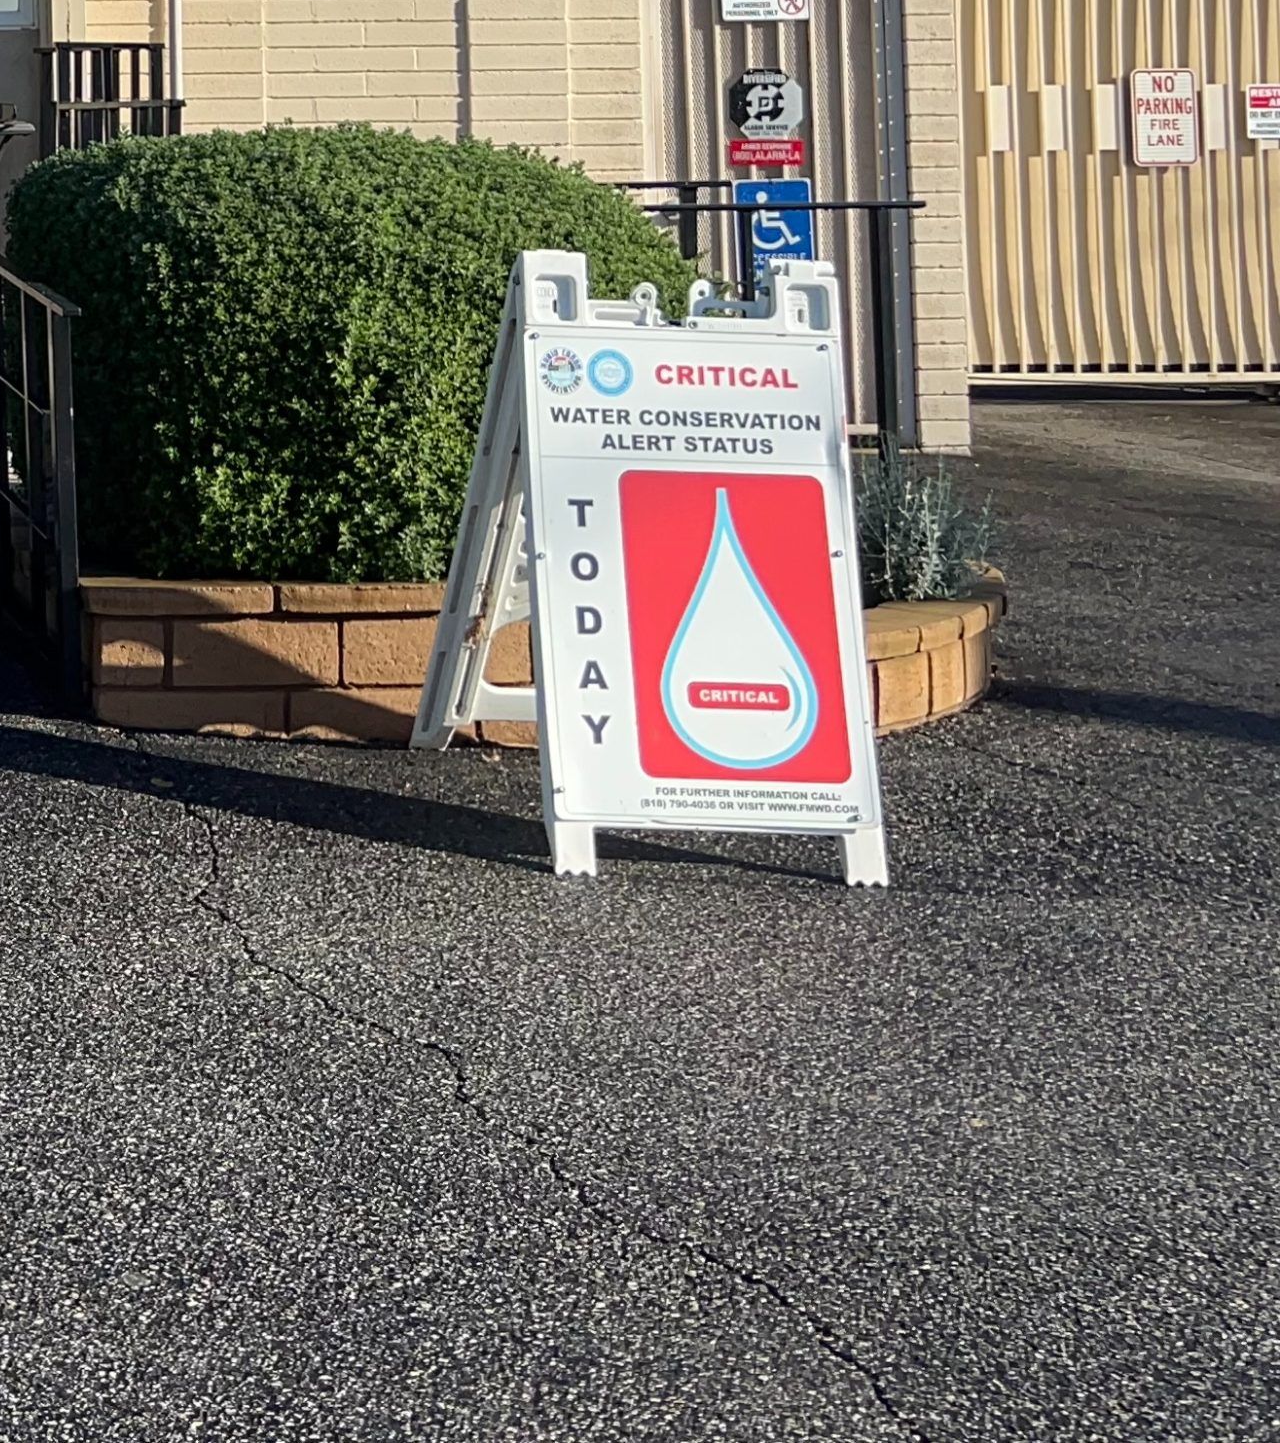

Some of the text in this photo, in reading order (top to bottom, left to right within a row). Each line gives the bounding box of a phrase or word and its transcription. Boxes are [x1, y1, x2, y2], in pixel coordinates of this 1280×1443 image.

[1152, 76, 1175, 93] NO
[1137, 98, 1192, 114] PARKING
[1150, 118, 1180, 131] FIRE
[1147, 134, 1184, 146] LANE
[654, 364, 798, 389] CRITICAL
[550, 406, 821, 431] WATER CONSERVATION
[601, 433, 774, 454] ALERT STATUS
[567, 498, 611, 745] TODAY
[699, 689, 779, 704] CRITICAL
[655, 787, 842, 801] FOR FURTHER INFORMATION CALL:
[640, 799, 666, 809] (818)
[719, 801, 734, 810] OR
[737, 801, 764, 811] VISIT
[768, 803, 859, 814] WWW.FMWD.COM
